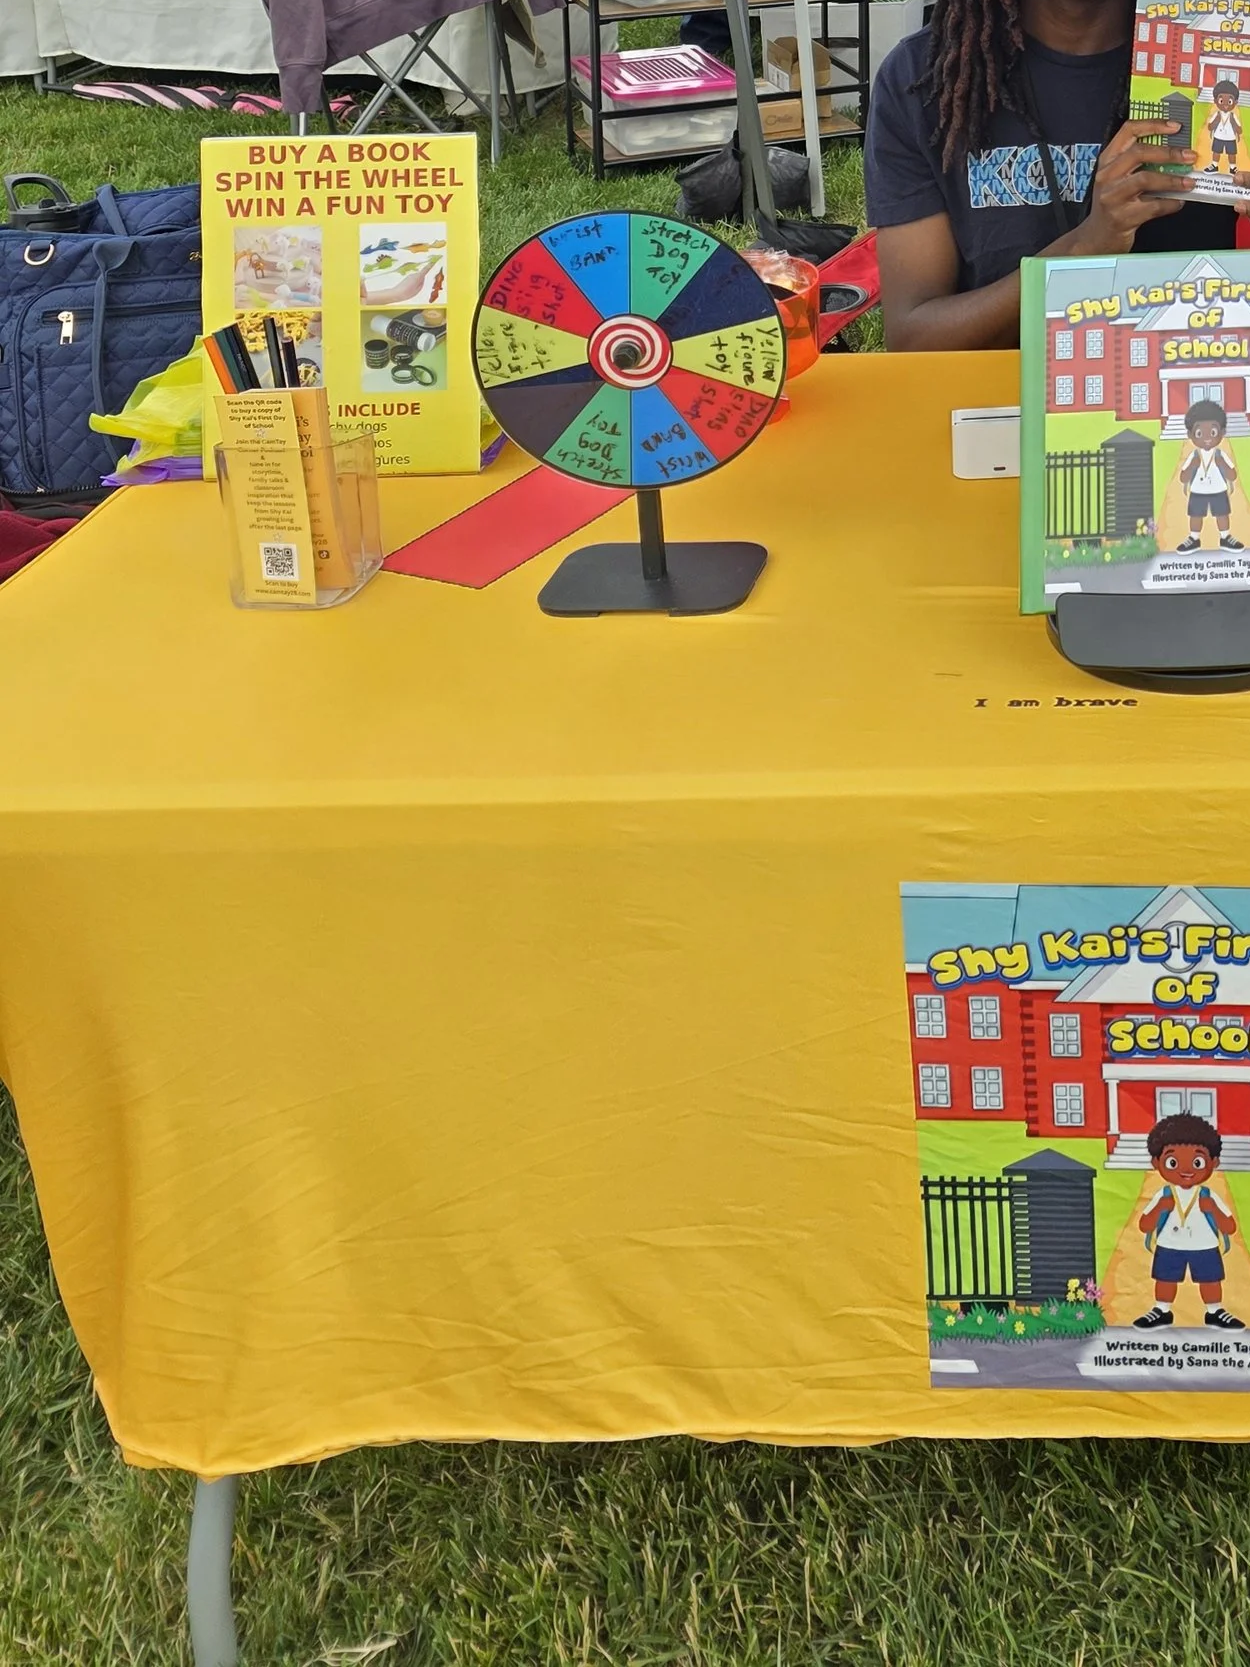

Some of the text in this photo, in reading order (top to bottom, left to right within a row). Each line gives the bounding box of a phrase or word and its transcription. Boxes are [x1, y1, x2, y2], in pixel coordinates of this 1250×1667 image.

[1146, 2, 1180, 20] Shy
[1220, 19, 1244, 32] of
[248, 141, 431, 165] BUY A BOOK
[215, 167, 464, 193] SPIN THE WHEEL
[225, 193, 454, 218] WIN A FUN TOY
[641, 220, 710, 252] Stretch
[647, 239, 690, 270] Dog
[1066, 294, 1121, 325] Shy
[1127, 281, 1196, 308] Kai's
[1188, 307, 1222, 328] of
[338, 403, 421, 418] INCLUDE
[1160, 562, 1192, 570] Written
[1195, 562, 1204, 570] by
[1207, 560, 1235, 568] Camille
[1153, 573, 1195, 582] Illustrated
[1198, 573, 1207, 581] by
[974, 696, 1138, 707] I am brave
[928, 942, 1031, 988] Shy
[1041, 927, 1170, 965] Kai's
[1153, 971, 1218, 1007] of
[1106, 1341, 1159, 1352] Written
[1163, 1343, 1178, 1354] by
[1182, 1342, 1230, 1353] Camille
[1094, 1356, 1164, 1366] Illustrated
[1168, 1357, 1183, 1369] by
[1187, 1356, 1218, 1367] Sana
[1222, 1357, 1244, 1368] the
